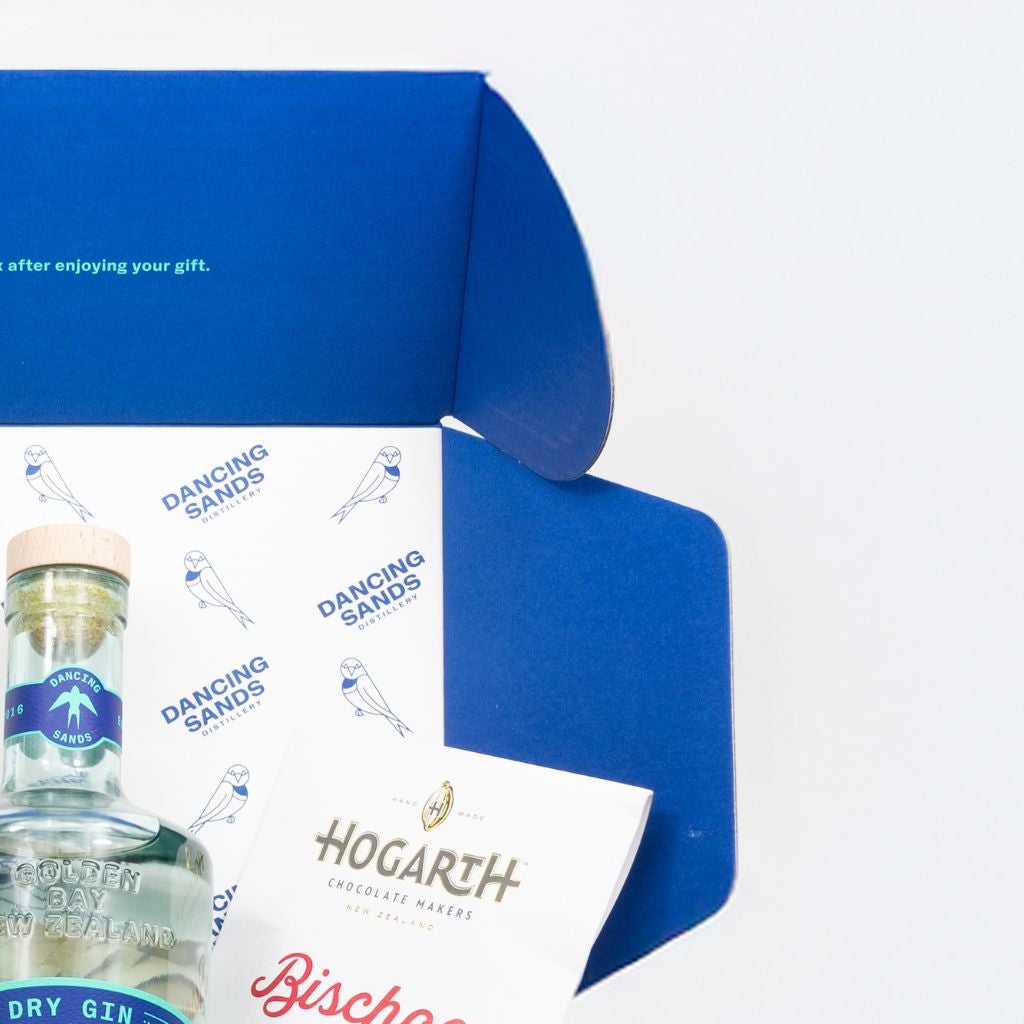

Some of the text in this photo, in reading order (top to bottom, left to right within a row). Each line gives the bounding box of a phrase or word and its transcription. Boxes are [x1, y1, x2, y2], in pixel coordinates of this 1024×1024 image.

[8, 258, 50, 272] after
[55, 258, 127, 275] enjoying
[132, 261, 170, 275] your
[174, 258, 211, 275] gift.
[161, 444, 269, 512] DANCING
[185, 467, 265, 520] SANDS
[317, 550, 425, 618] DANCING
[340, 573, 422, 627] SANDS
[358, 593, 418, 631] DISTILLERY
[49, 671, 101, 694] DANCING
[160, 656, 270, 725] DANCING
[184, 679, 265, 733] SANDS
[52, 729, 93, 745] SANDS
[14, 859, 142, 895] GOLDEN
[315, 817, 521, 903] HOGARTH
[46, 886, 109, 912] BAY
[328, 878, 473, 920] CHOCOLATE MAKERS
[43, 912, 177, 951] ZEALAND
[8, 997, 62, 1020] DRY
